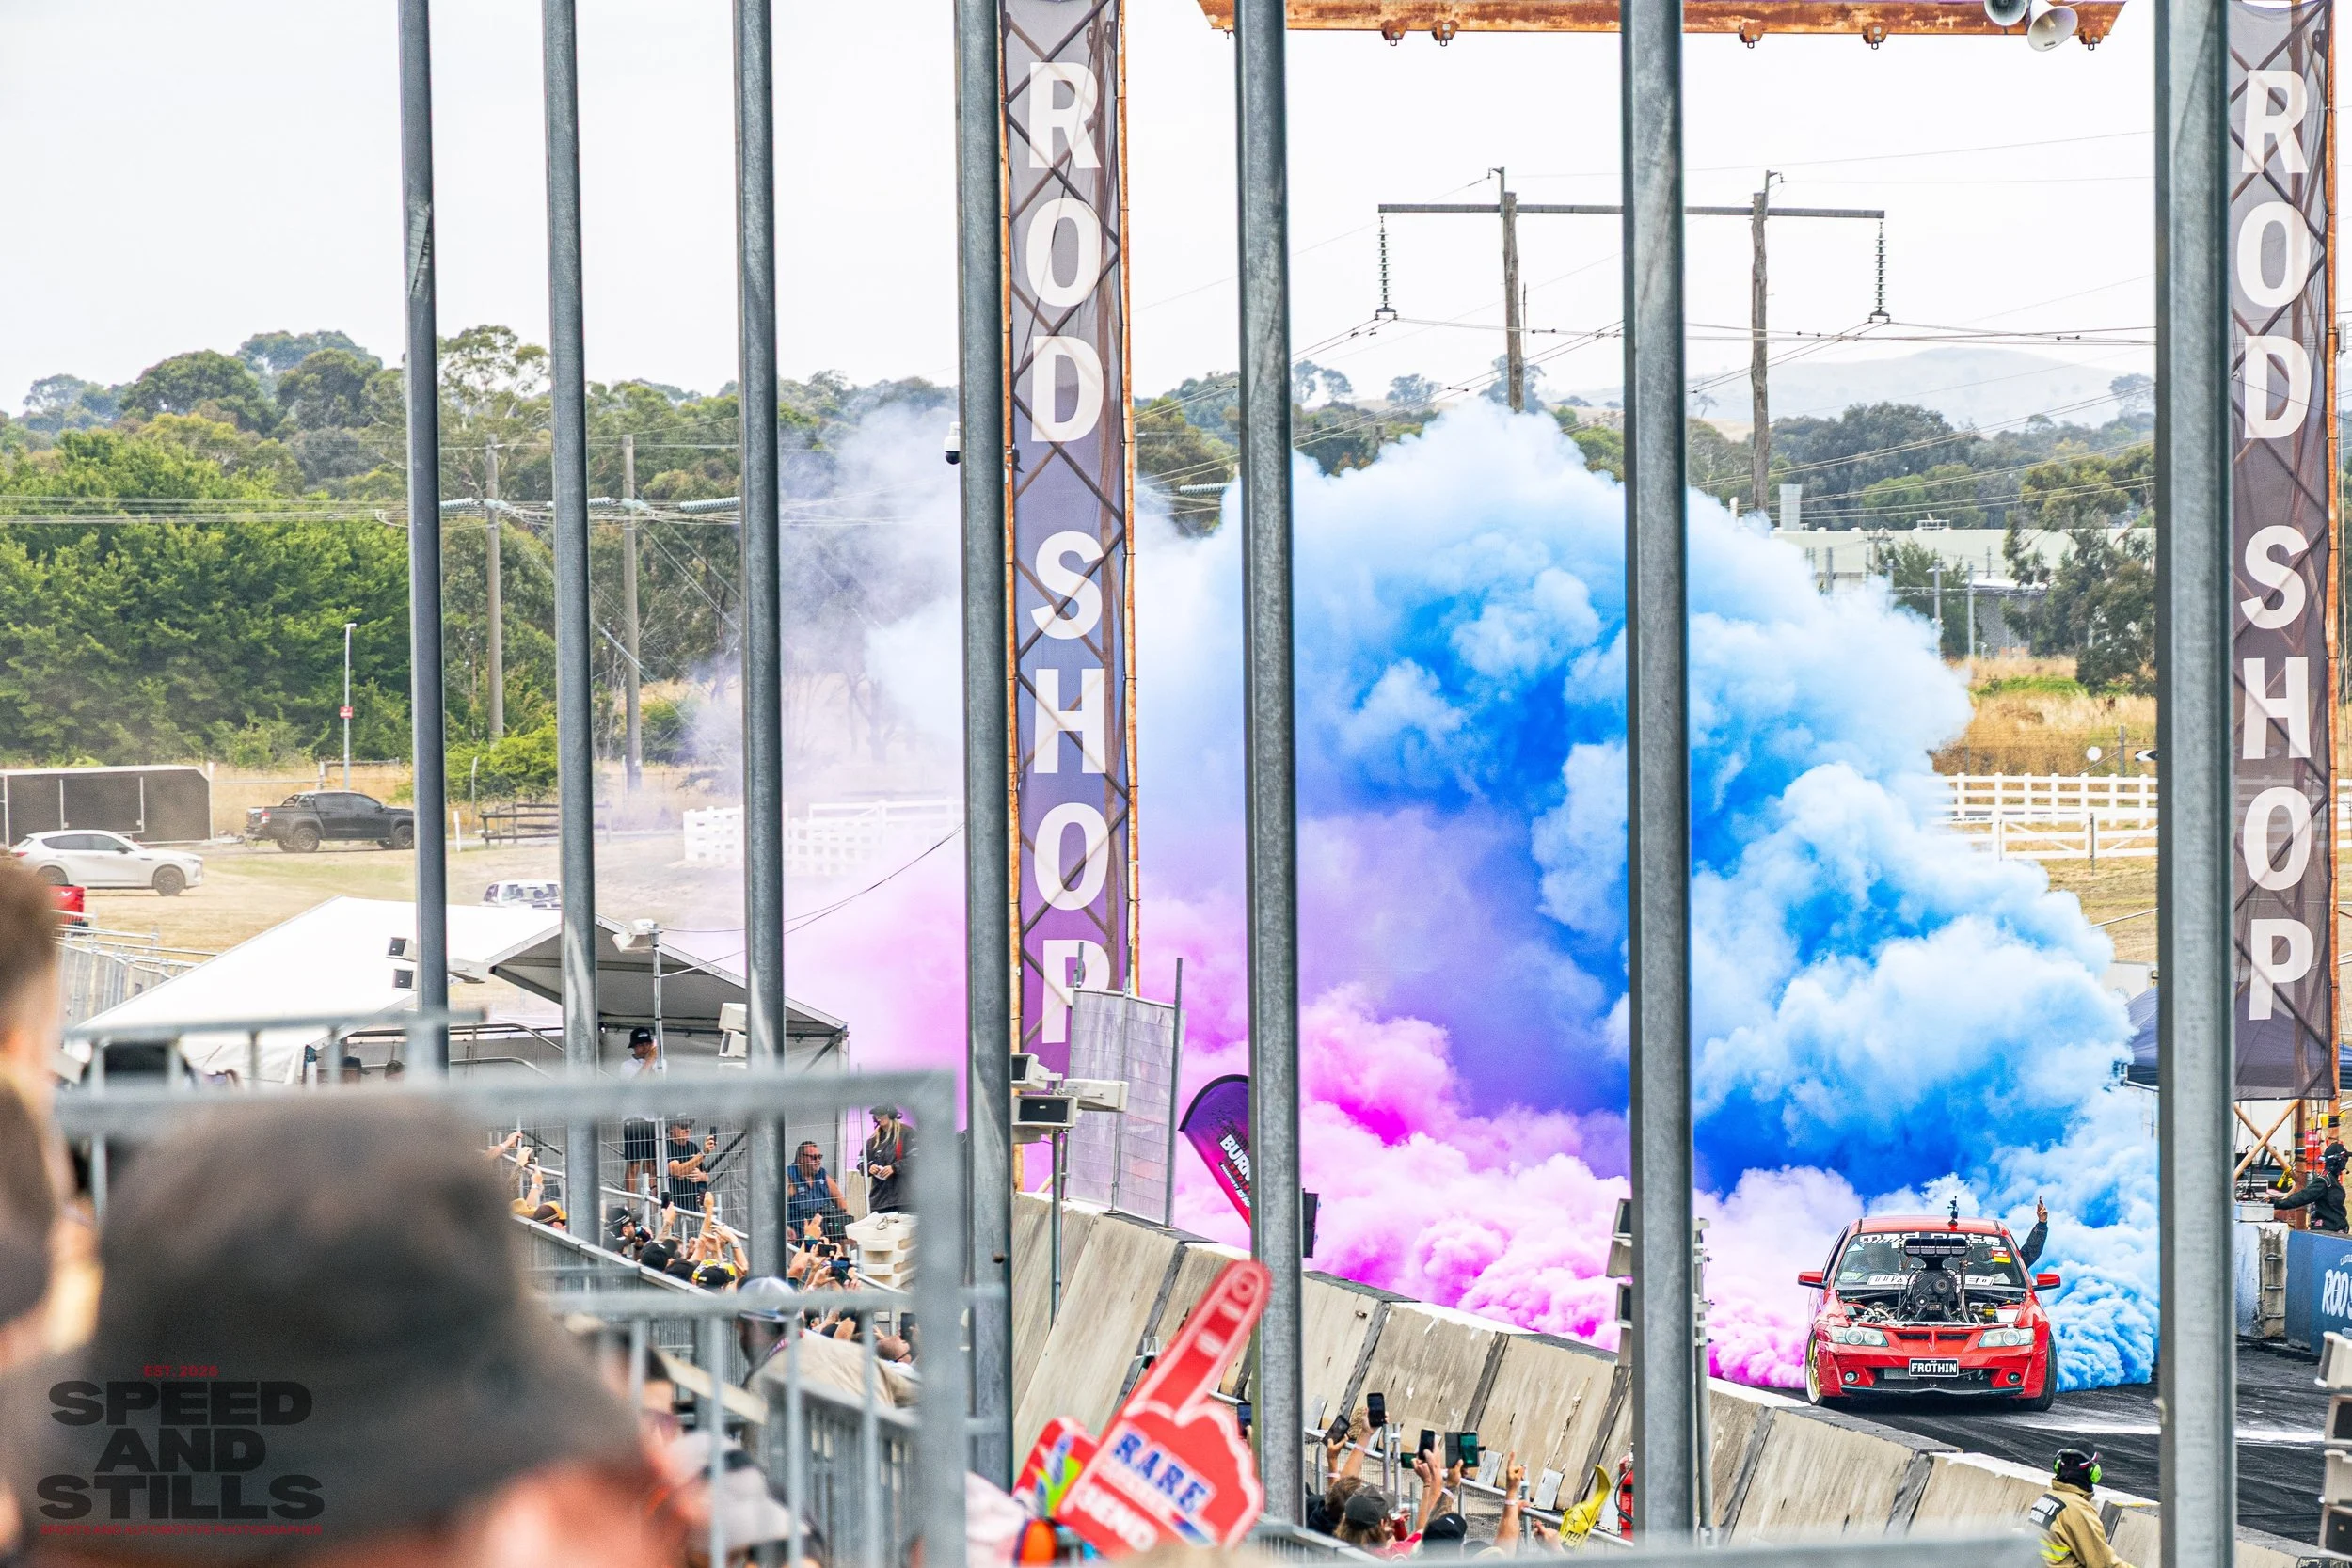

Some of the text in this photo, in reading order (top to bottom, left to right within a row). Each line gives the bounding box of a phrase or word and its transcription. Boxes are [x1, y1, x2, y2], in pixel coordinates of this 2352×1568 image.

[1025, 61, 1110, 1044] ROD SHOP
[2236, 69, 2313, 1021] ROD SHOP
[1911, 1362, 1957, 1373] FROTHIN
